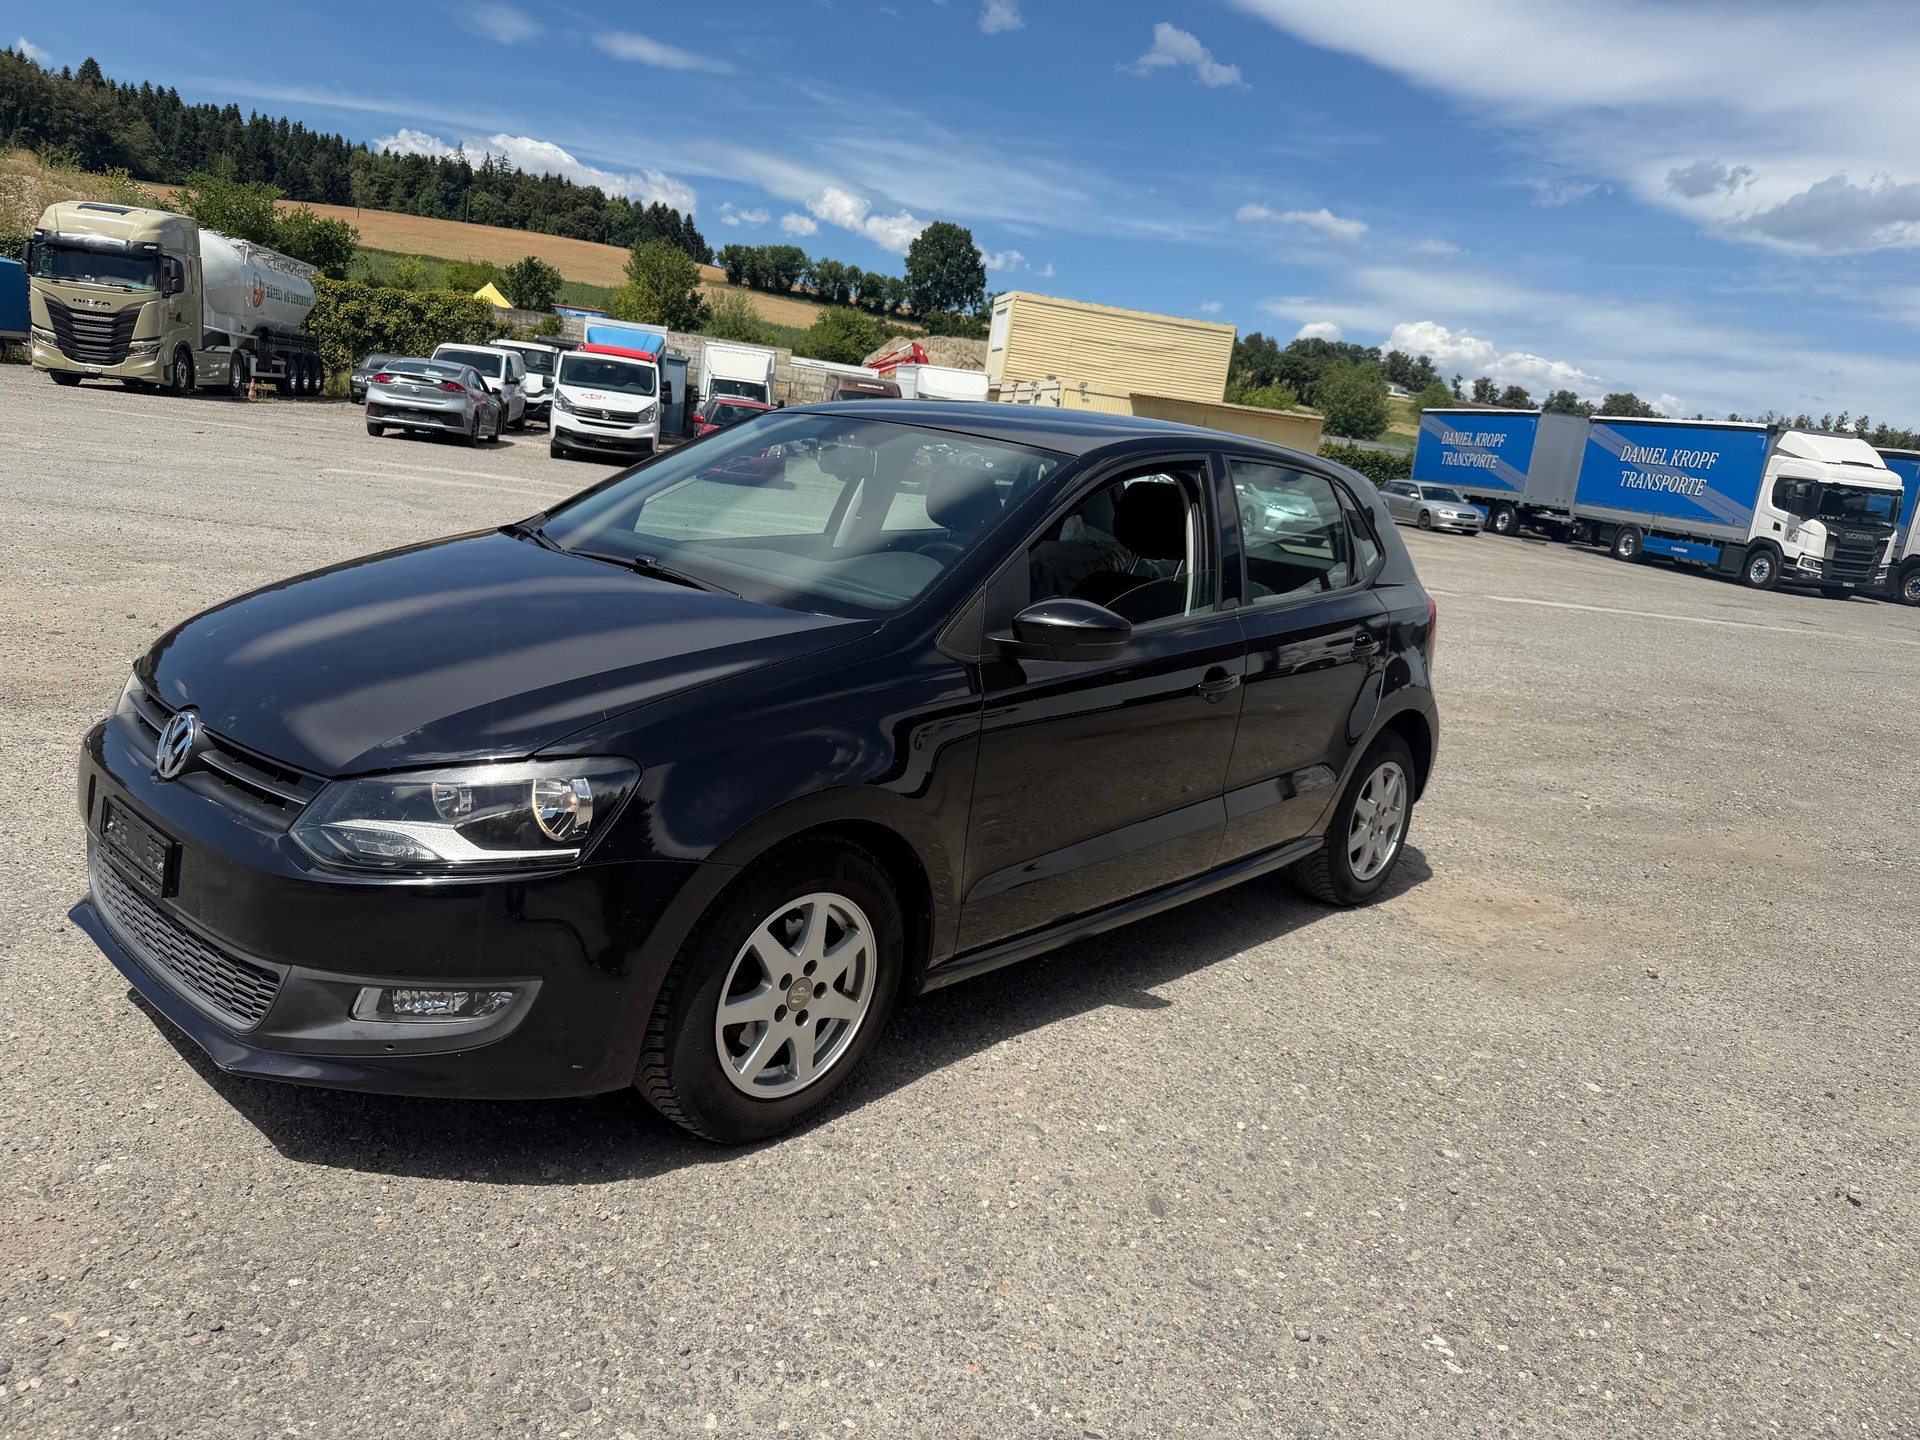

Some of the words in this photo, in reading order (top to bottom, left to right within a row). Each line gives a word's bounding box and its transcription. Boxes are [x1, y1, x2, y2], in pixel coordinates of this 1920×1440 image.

[1441, 432, 1473, 447] DANIEL
[1474, 432, 1507, 448] KROPF
[1441, 452, 1499, 469] TRANSPORTE
[1620, 445, 1667, 466] DANIEL
[1669, 449, 1719, 470] KROPF
[1620, 470, 1707, 497] TRANSPORTE
[1845, 532, 1873, 541] SCANIA
